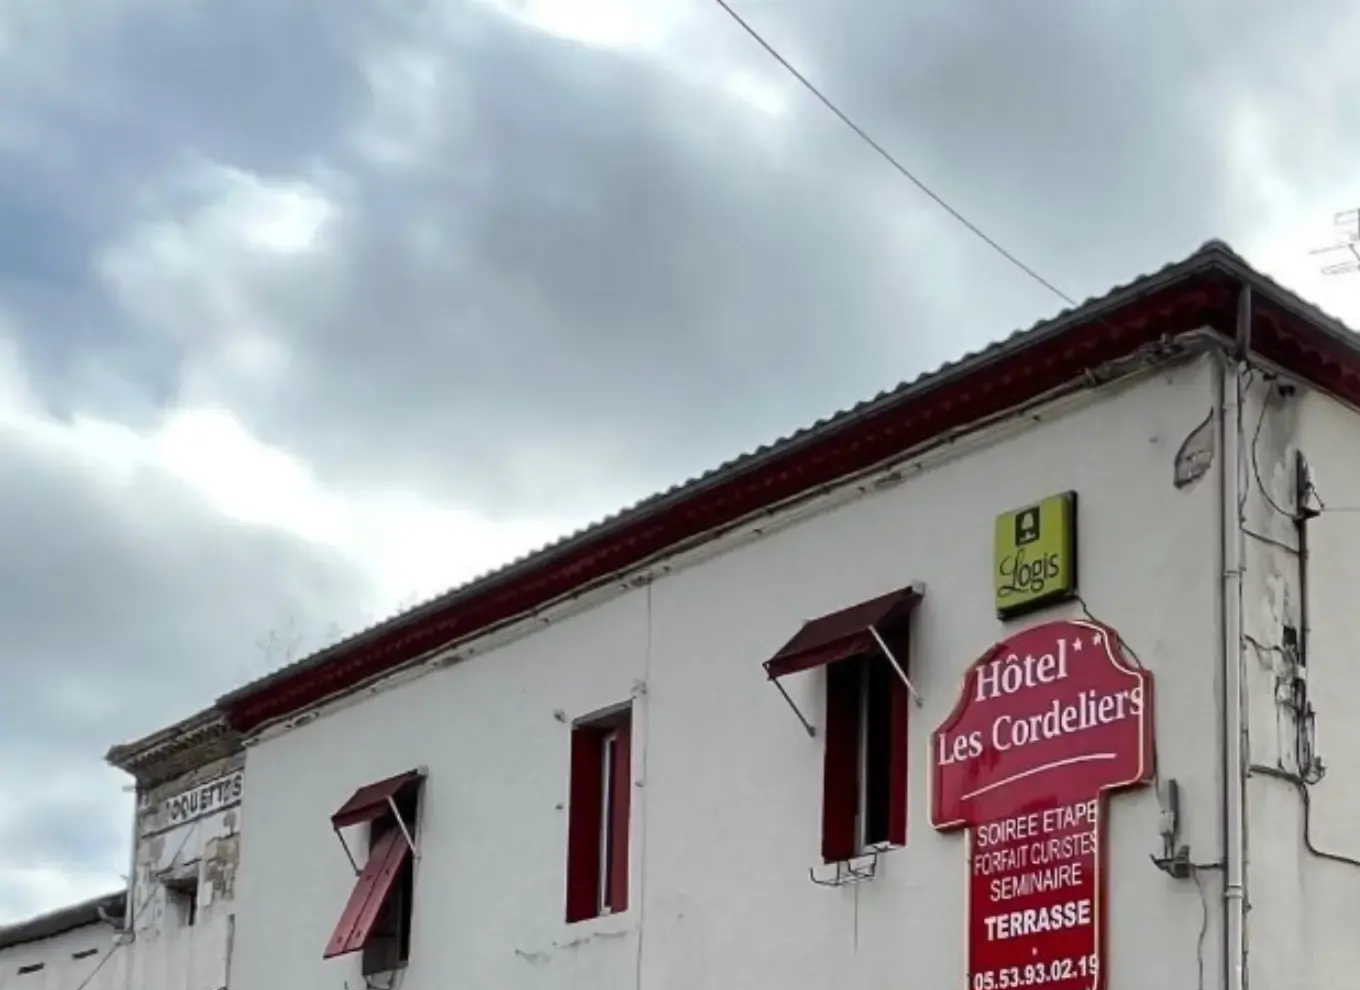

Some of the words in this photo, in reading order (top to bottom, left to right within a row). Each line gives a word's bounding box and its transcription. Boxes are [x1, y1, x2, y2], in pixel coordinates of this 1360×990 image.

[997, 548, 1060, 595] Logis
[974, 638, 1068, 702] Hôtel
[938, 730, 983, 765] Les
[992, 687, 1143, 751] Cordeliers
[977, 813, 1038, 848] SOIREE
[1043, 799, 1098, 833] ETAPE
[974, 846, 1029, 877] FORFAIT
[1030, 830, 1098, 865] CURISTES
[990, 862, 1083, 902] SEMINAIRE
[984, 899, 1091, 941] TERRASSE
